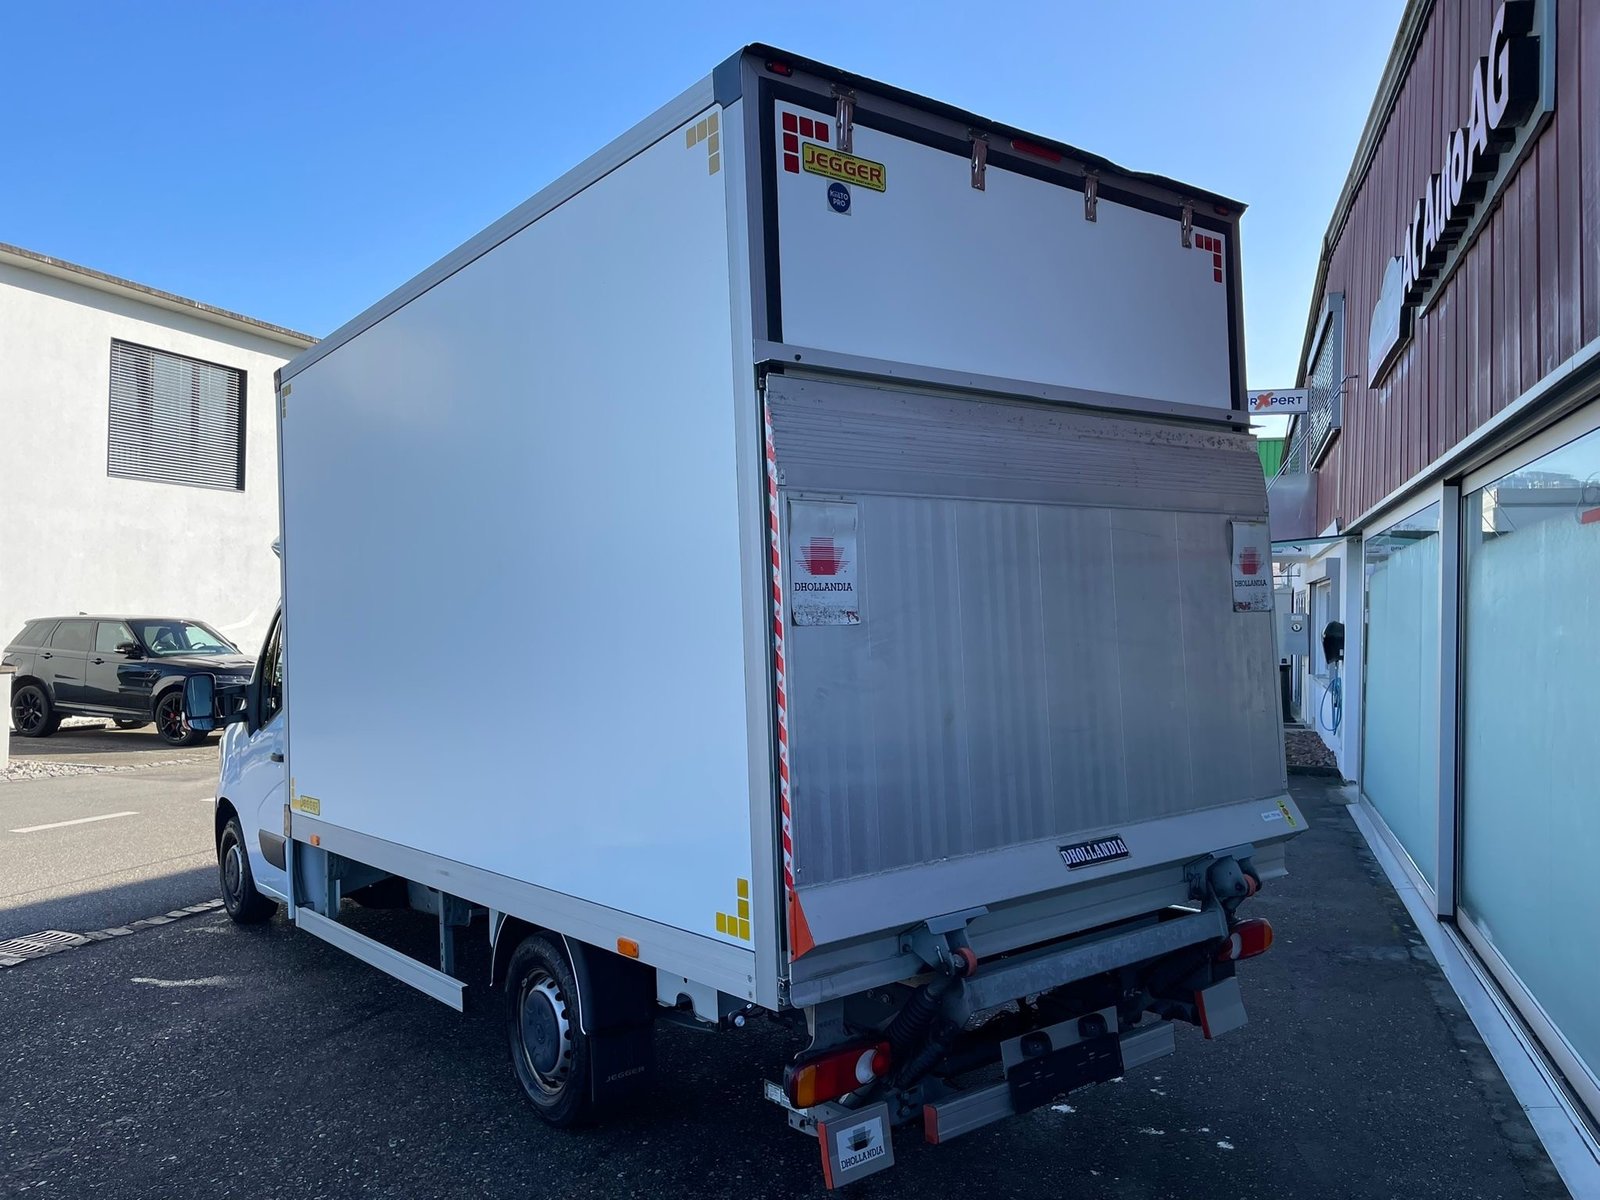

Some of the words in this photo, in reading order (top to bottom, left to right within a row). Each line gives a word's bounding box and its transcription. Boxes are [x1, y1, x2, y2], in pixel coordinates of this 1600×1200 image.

[1466, 3, 1510, 182] AG
[805, 150, 884, 186] JEGGER
[832, 197, 846, 207] PRO
[794, 582, 853, 592] DHOLLANDIA
[1234, 579, 1267, 587] DHOLLANDIA
[1060, 839, 1128, 865] DHOLLANDIA
[841, 1145, 884, 1169] DHOLLANDIA
